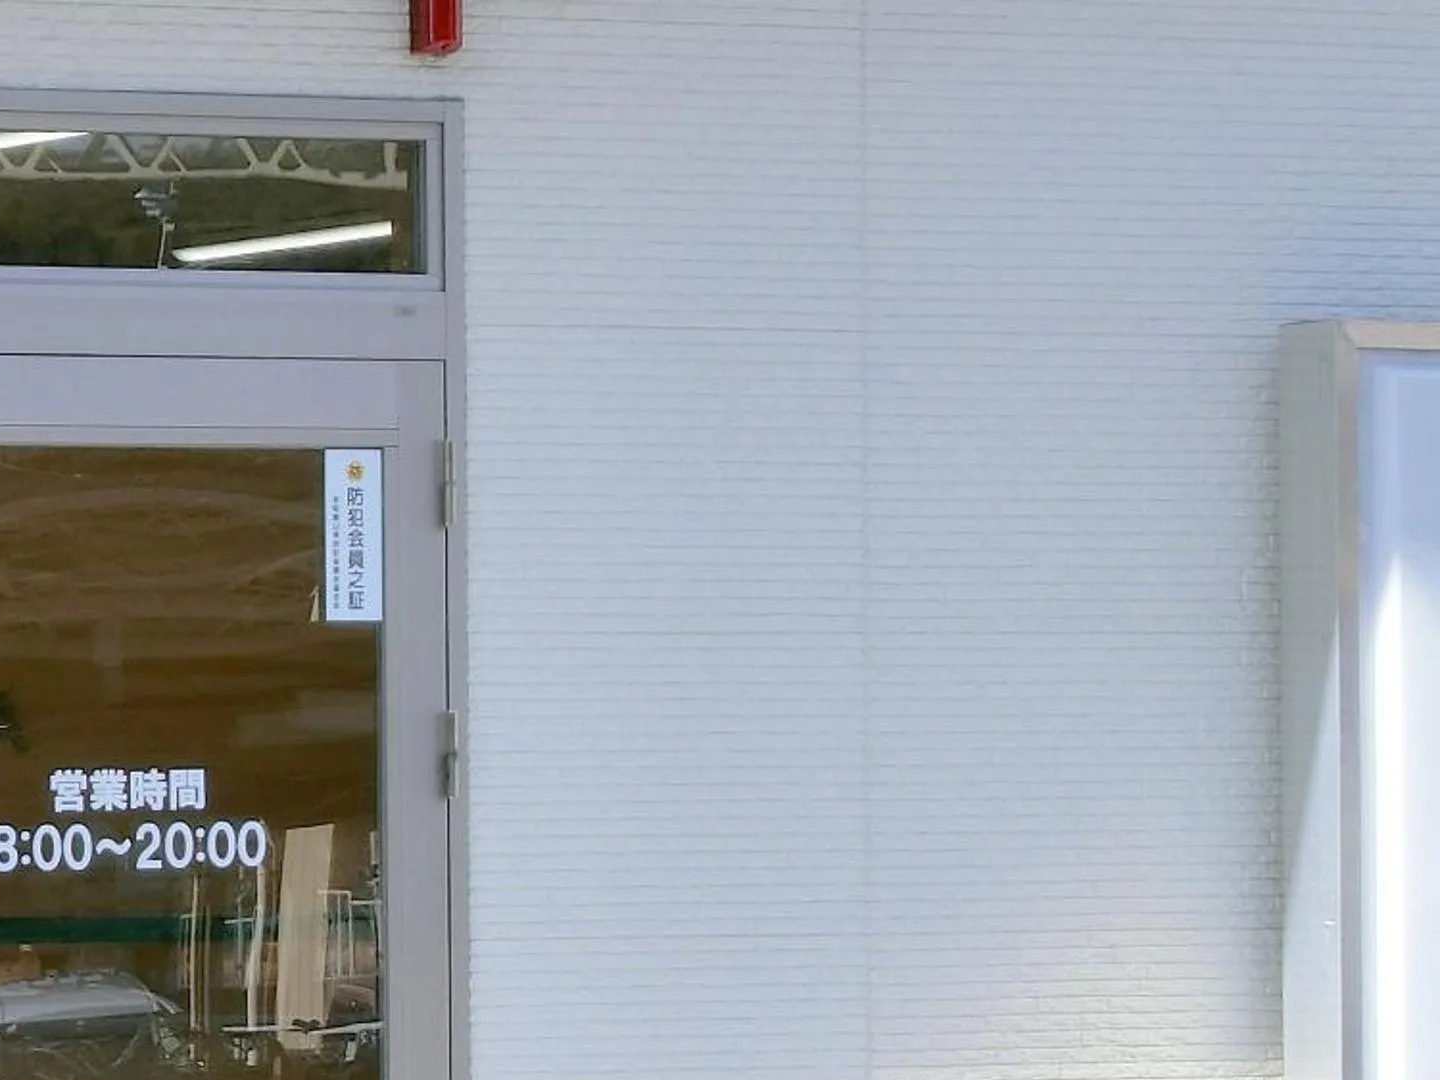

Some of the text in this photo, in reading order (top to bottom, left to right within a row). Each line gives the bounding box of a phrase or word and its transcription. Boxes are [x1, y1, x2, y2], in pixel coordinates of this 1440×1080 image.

[346, 487, 365, 610] 防犯会員之証
[49, 768, 206, 811] 営業時間
